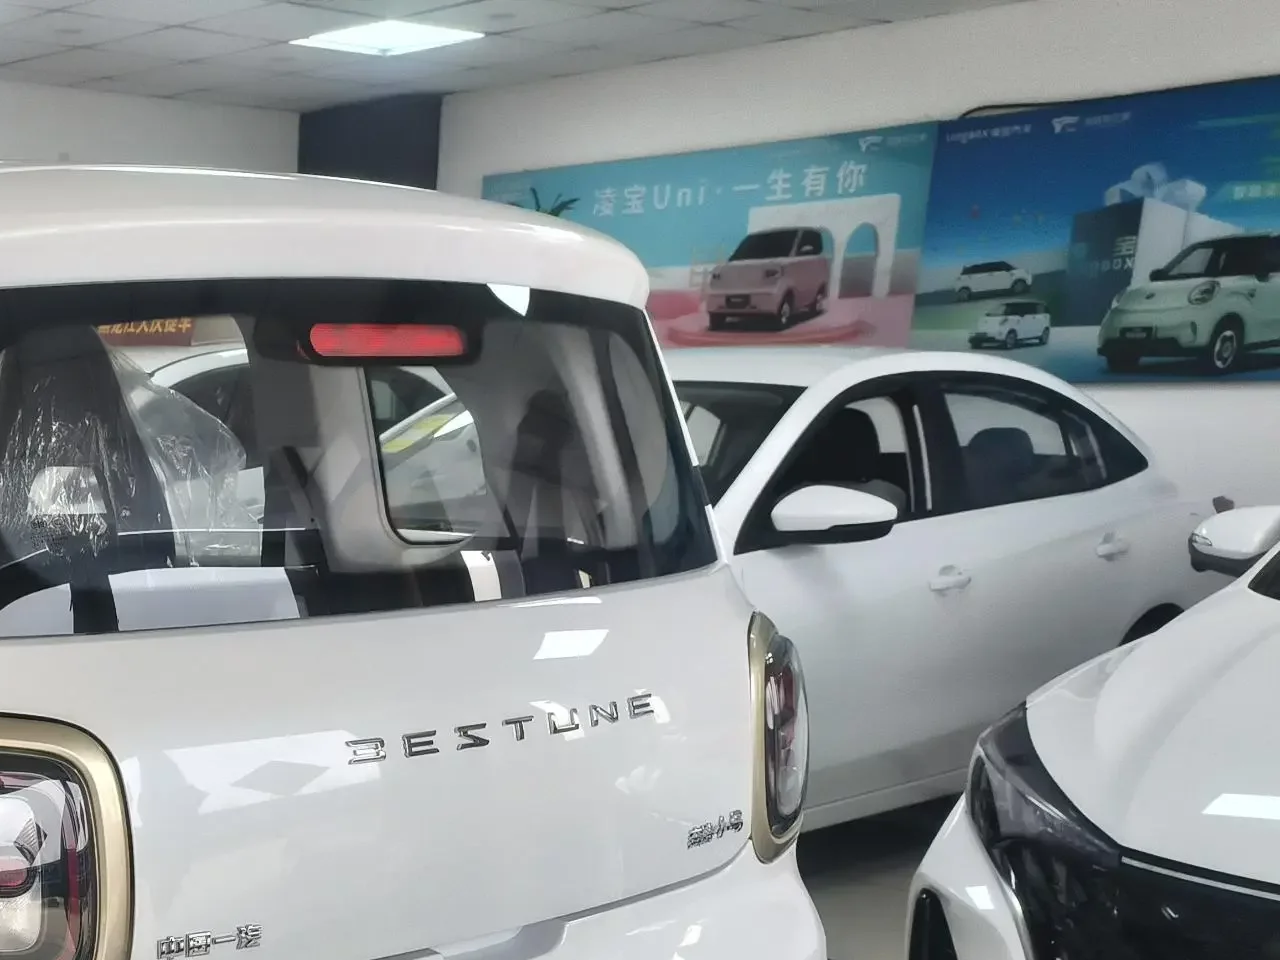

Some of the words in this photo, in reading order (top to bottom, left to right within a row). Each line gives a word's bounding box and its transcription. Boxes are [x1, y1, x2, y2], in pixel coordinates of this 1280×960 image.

[344, 692, 656, 766] BESTUNE
[156, 923, 263, 960] 中国一汽
